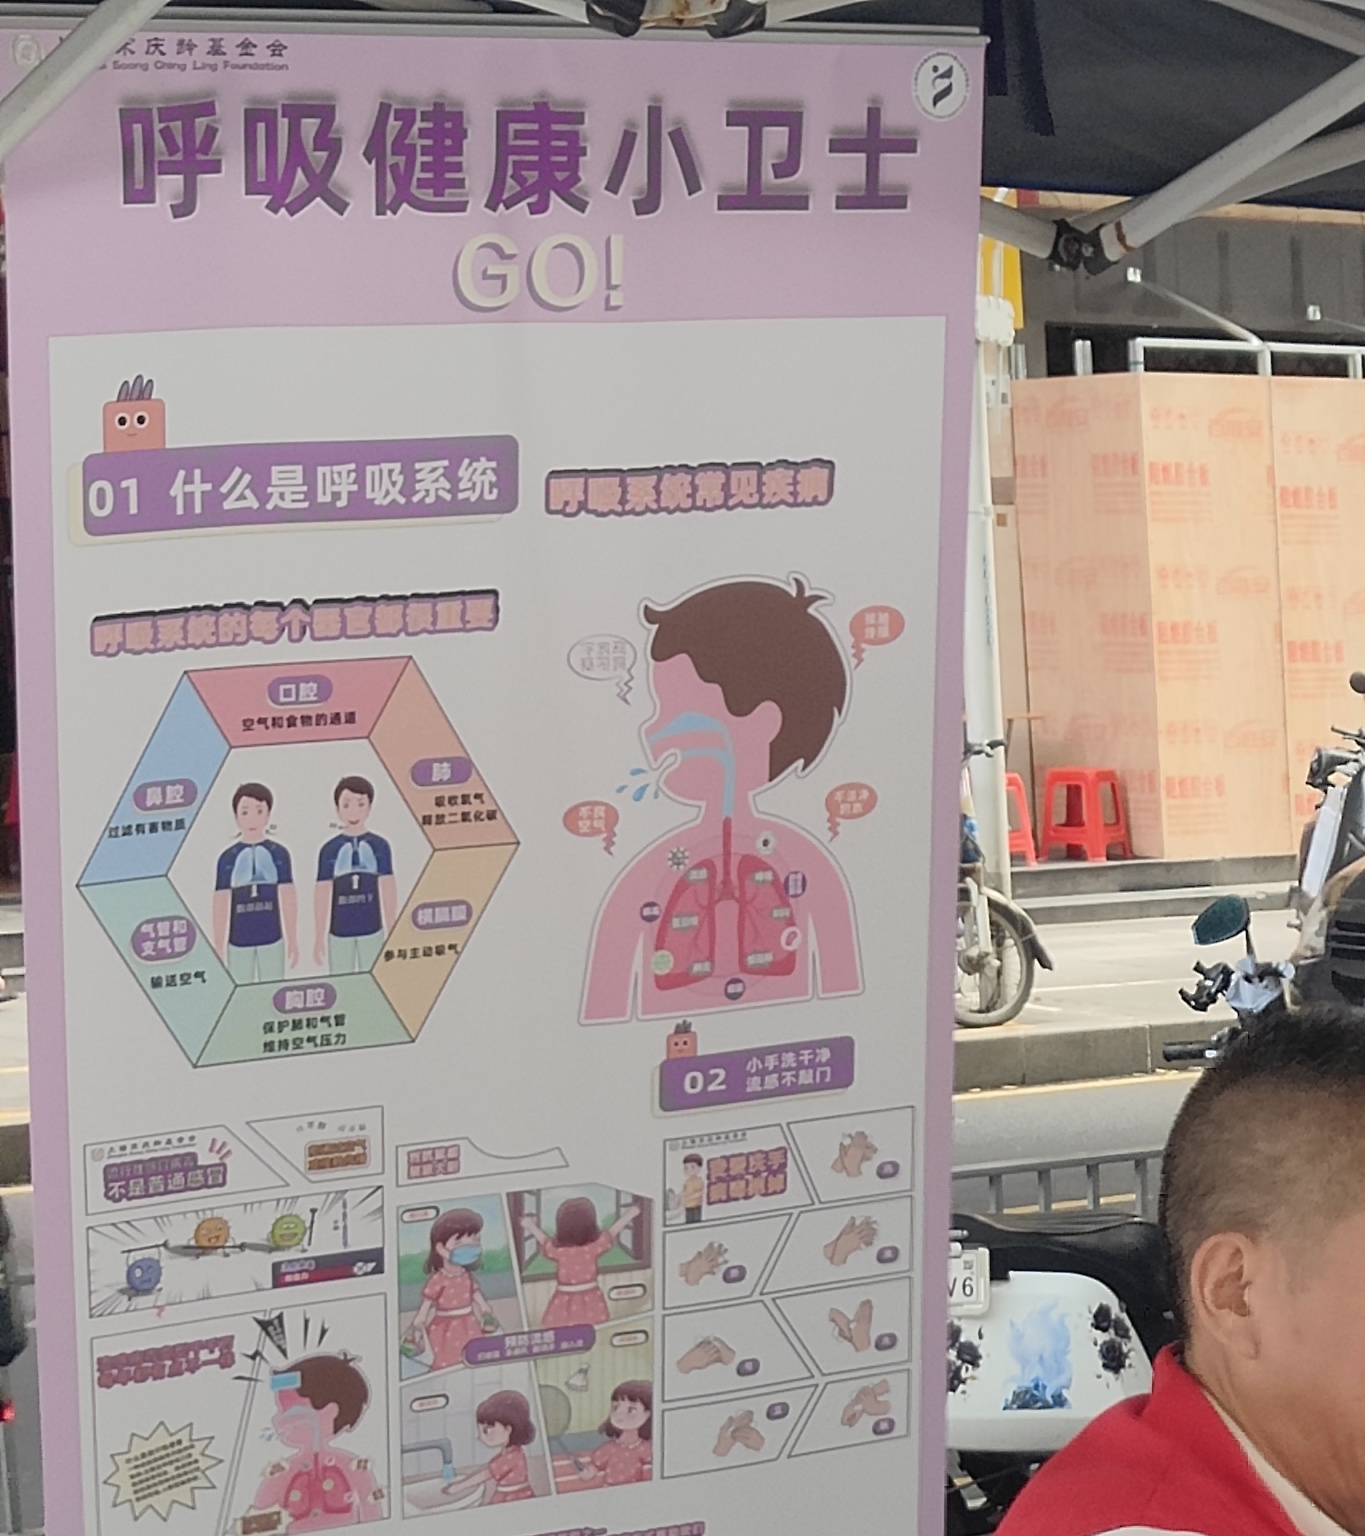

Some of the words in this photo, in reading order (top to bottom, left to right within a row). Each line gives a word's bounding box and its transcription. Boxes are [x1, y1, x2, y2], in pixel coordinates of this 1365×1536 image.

[117, 97, 919, 220] 呼吸健康小卫士
[455, 232, 625, 312] GO!
[88, 480, 139, 517] 01
[169, 456, 499, 516] 什么是呼吸系统
[547, 462, 833, 515] 呼吸系统常见疾病
[279, 682, 319, 703] 口腔
[242, 711, 357, 732] 空气和食物的通道
[145, 784, 185, 806] 鼻腔
[285, 988, 326, 1009] 胸腔
[262, 1014, 346, 1035] 保护肺和气管
[262, 1033, 347, 1054] 维持空气压力
[684, 1068, 727, 1094] 02
[746, 1048, 831, 1072] 小手洗干净
[108, 1166, 225, 1199] 不是普通感冒
